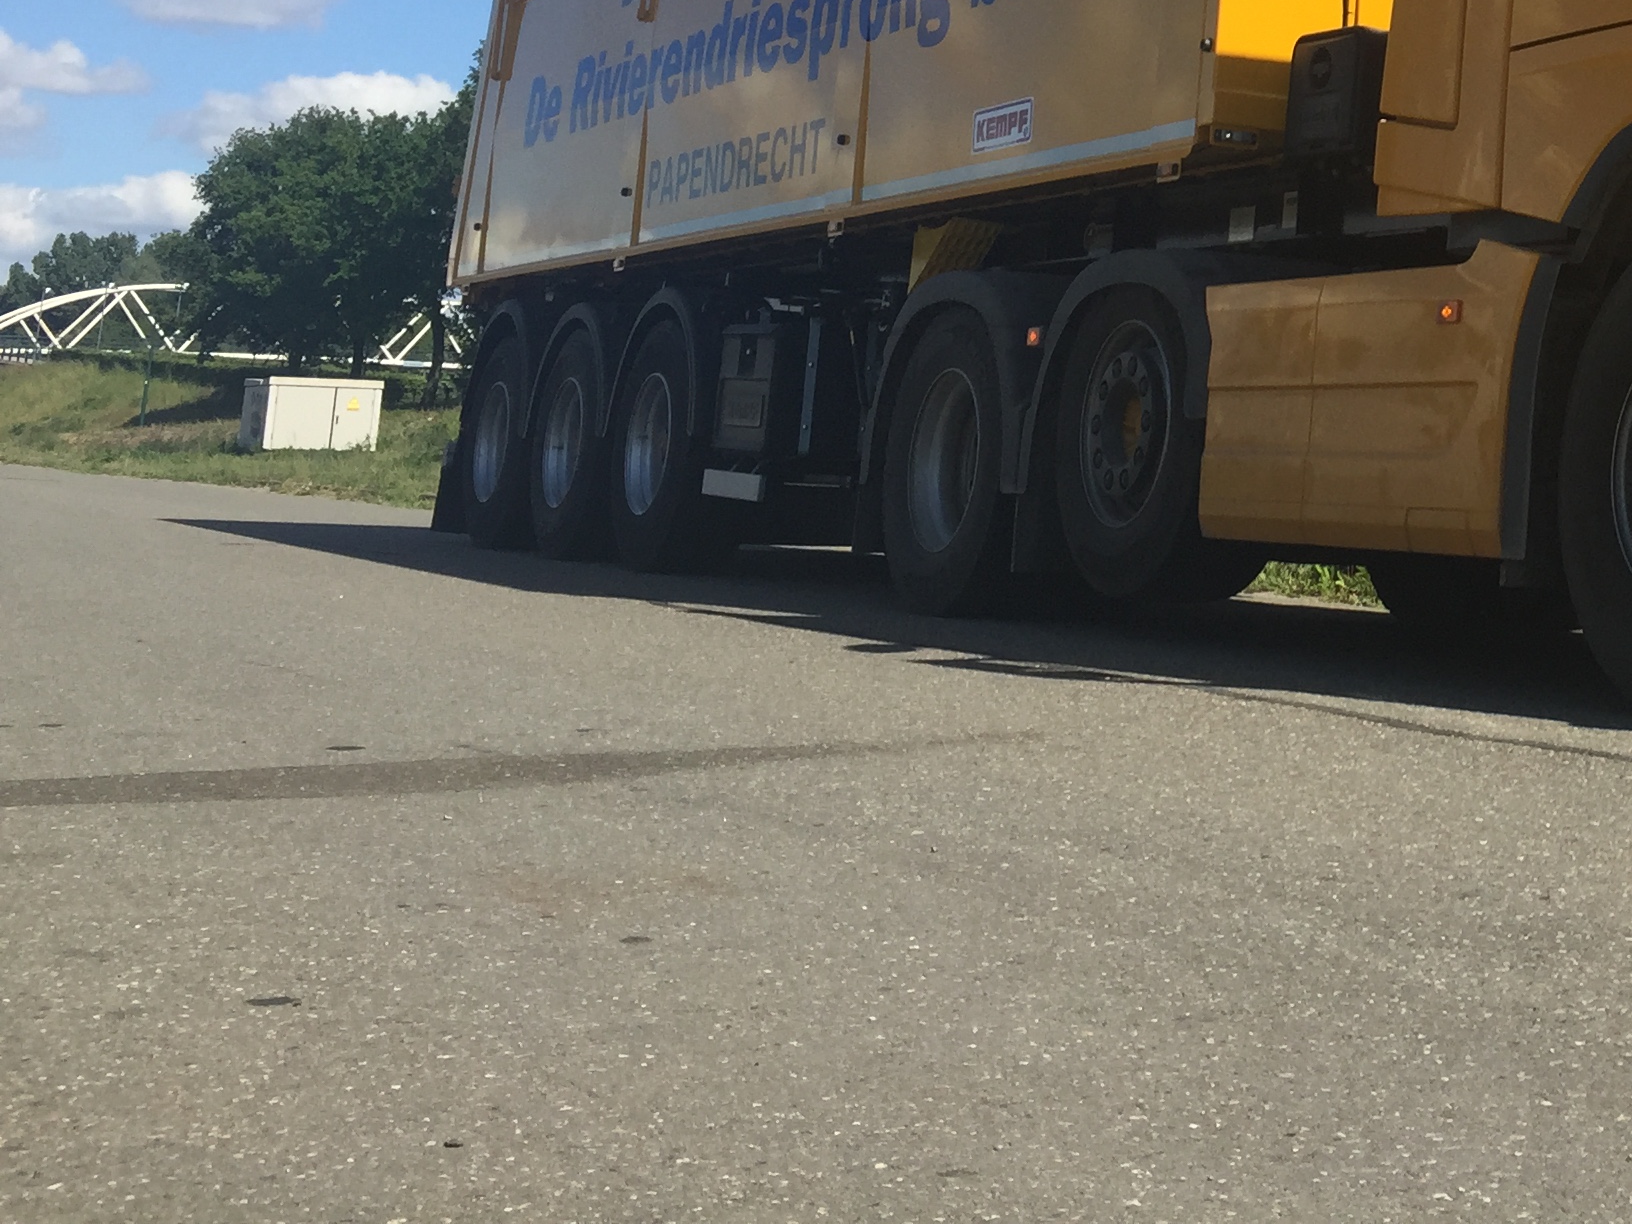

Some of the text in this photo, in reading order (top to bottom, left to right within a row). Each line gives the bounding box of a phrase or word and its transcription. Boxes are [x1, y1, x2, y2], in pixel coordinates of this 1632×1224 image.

[523, 75, 562, 148] De
[976, 108, 1029, 144] KEMPF
[647, 119, 827, 209] PAPENDRECHT
